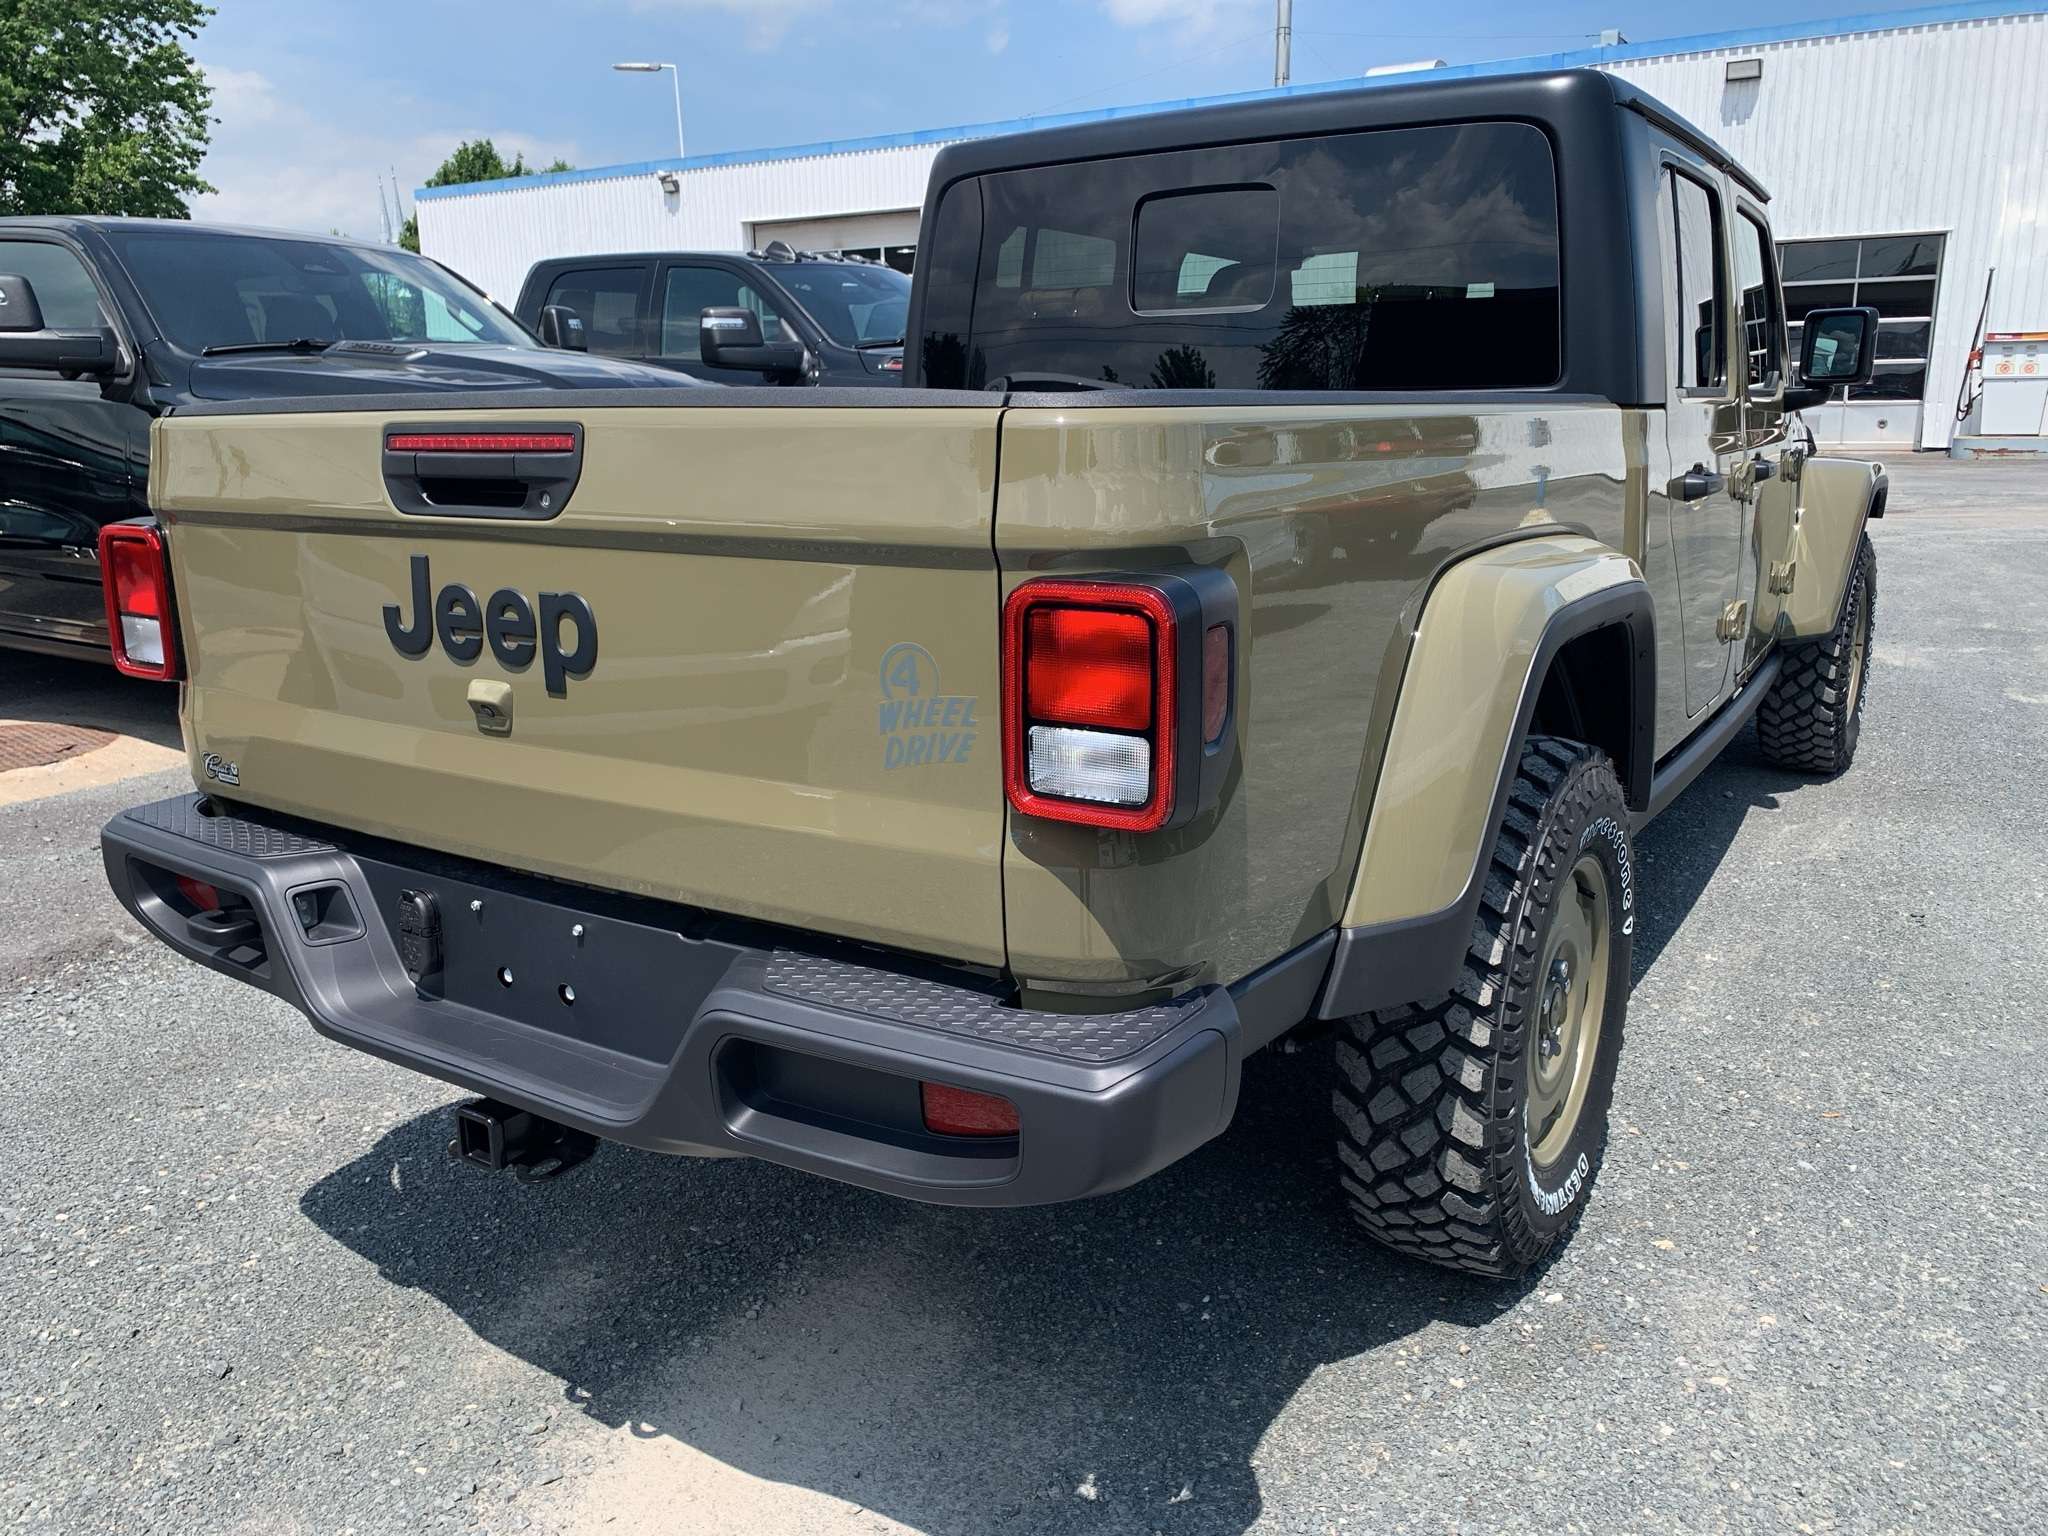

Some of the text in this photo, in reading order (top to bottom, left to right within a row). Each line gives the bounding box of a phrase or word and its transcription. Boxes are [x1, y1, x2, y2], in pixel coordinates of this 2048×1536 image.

[61, 545, 99, 560] RA
[382, 554, 598, 697] Jeep
[889, 654, 918, 696] 4
[878, 697, 978, 734] WHEEL
[883, 732, 977, 769] DRIVE
